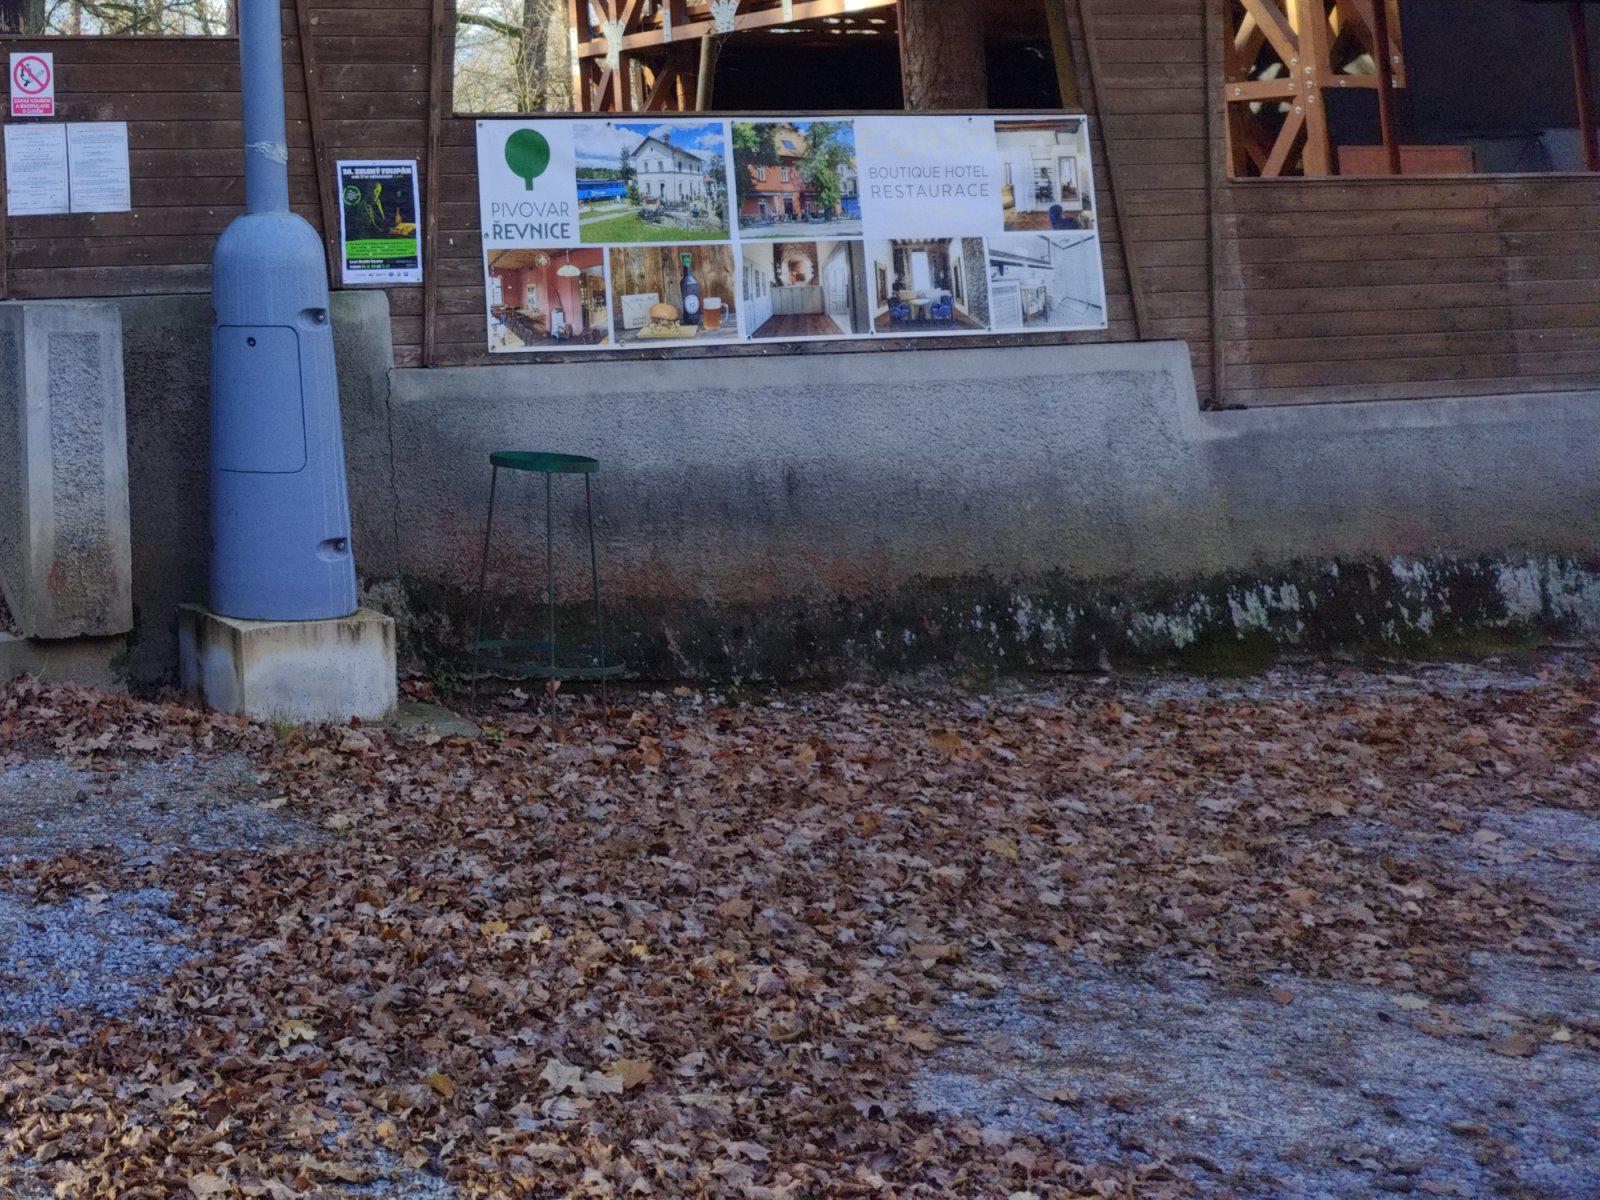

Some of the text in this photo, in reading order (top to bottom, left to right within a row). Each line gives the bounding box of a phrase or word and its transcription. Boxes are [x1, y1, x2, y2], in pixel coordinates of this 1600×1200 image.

[869, 165, 989, 179] BOUTIQUE HOTEL
[870, 183, 990, 199] RESTAURACE
[491, 202, 569, 217] PIVOVAR
[492, 220, 571, 239] ŘEVNICE
